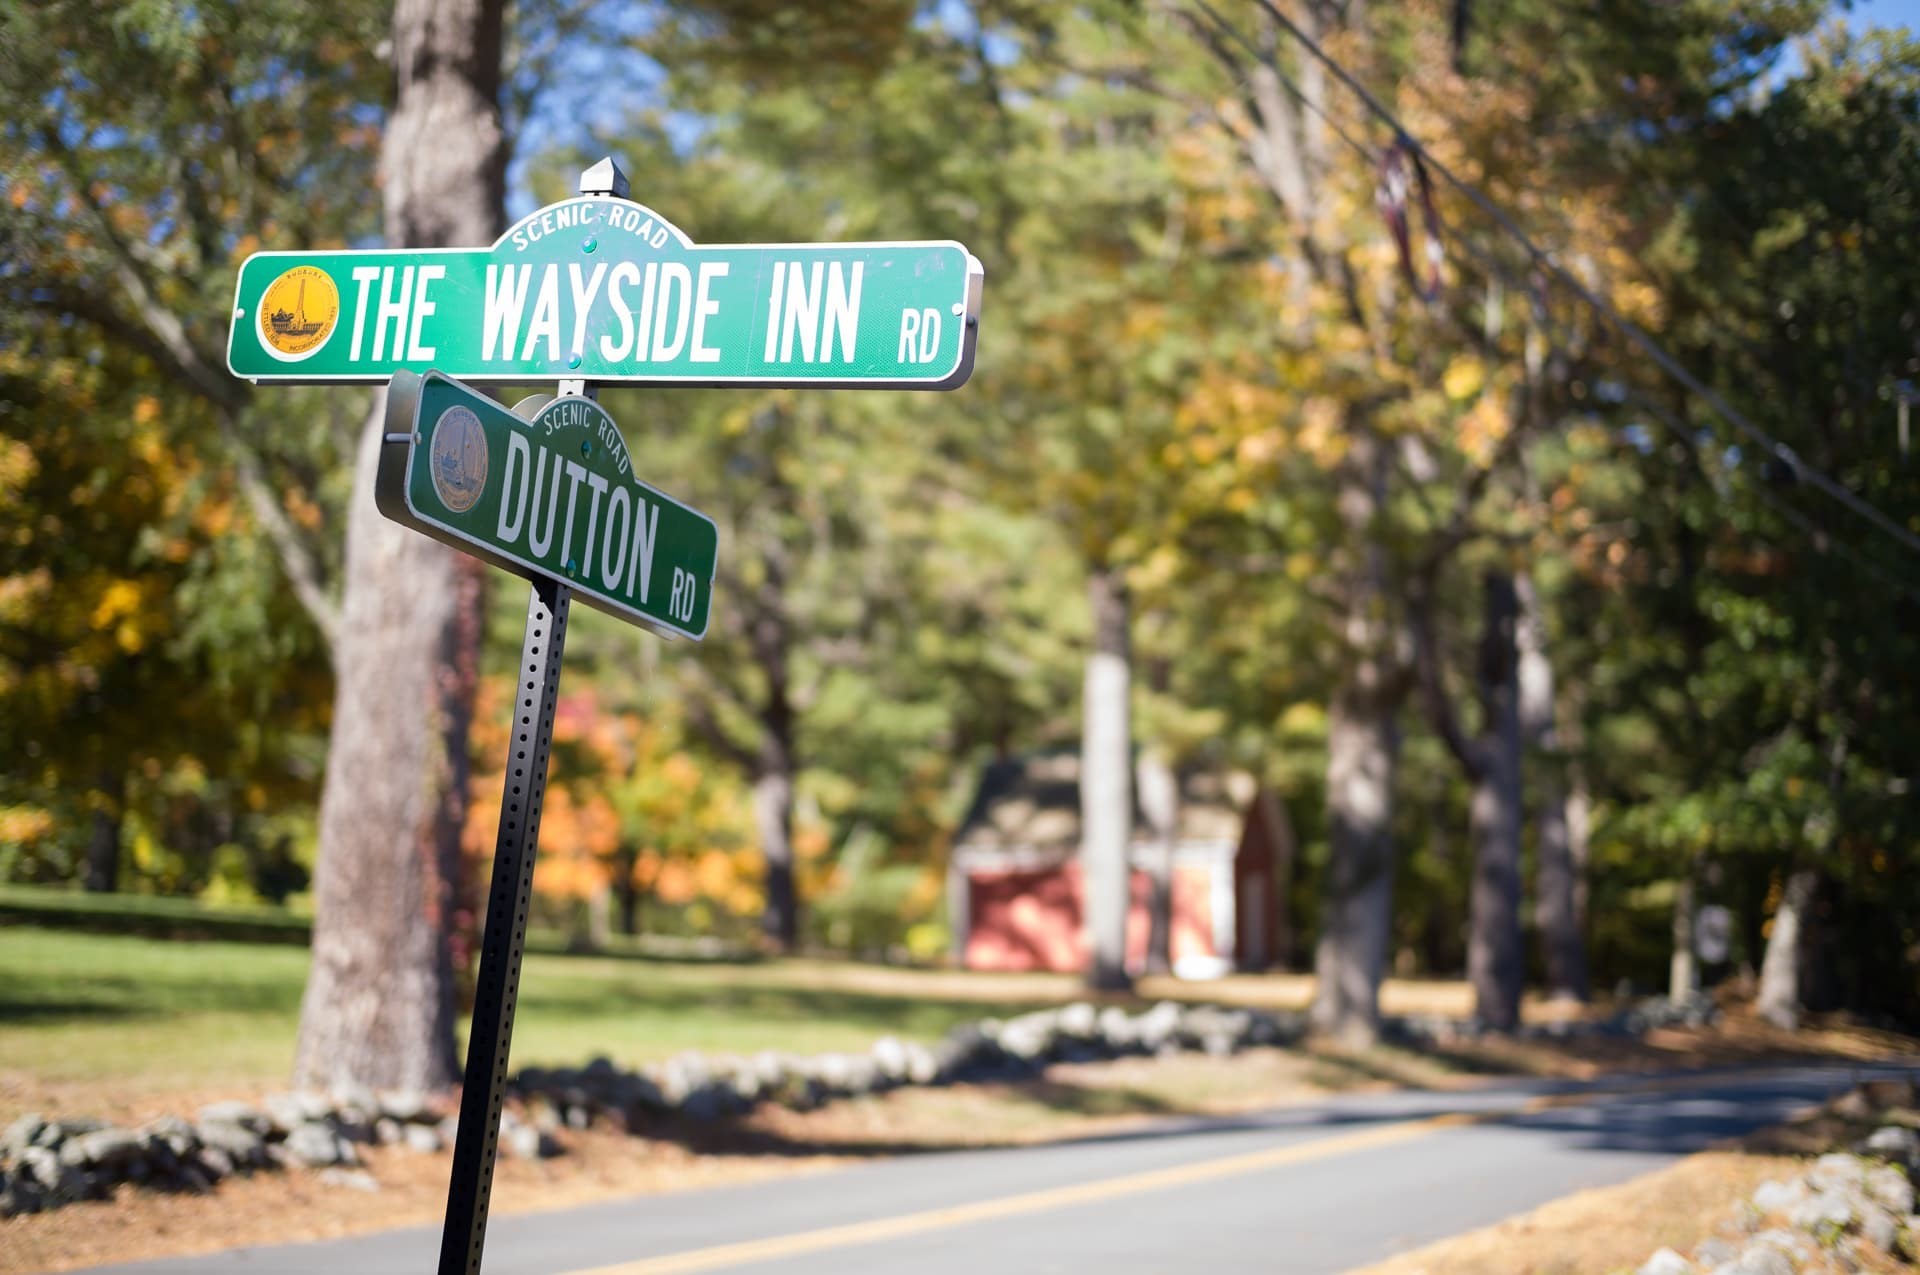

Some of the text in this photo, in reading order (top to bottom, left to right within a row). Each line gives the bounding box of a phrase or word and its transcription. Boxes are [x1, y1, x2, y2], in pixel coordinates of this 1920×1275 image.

[512, 203, 669, 252] SCENIC ROAD
[349, 261, 942, 364] THE WAYSIDE INN RD
[544, 403, 628, 474] SCENIC ROAD
[496, 430, 659, 604] DUTTON
[669, 566, 696, 624] RD
